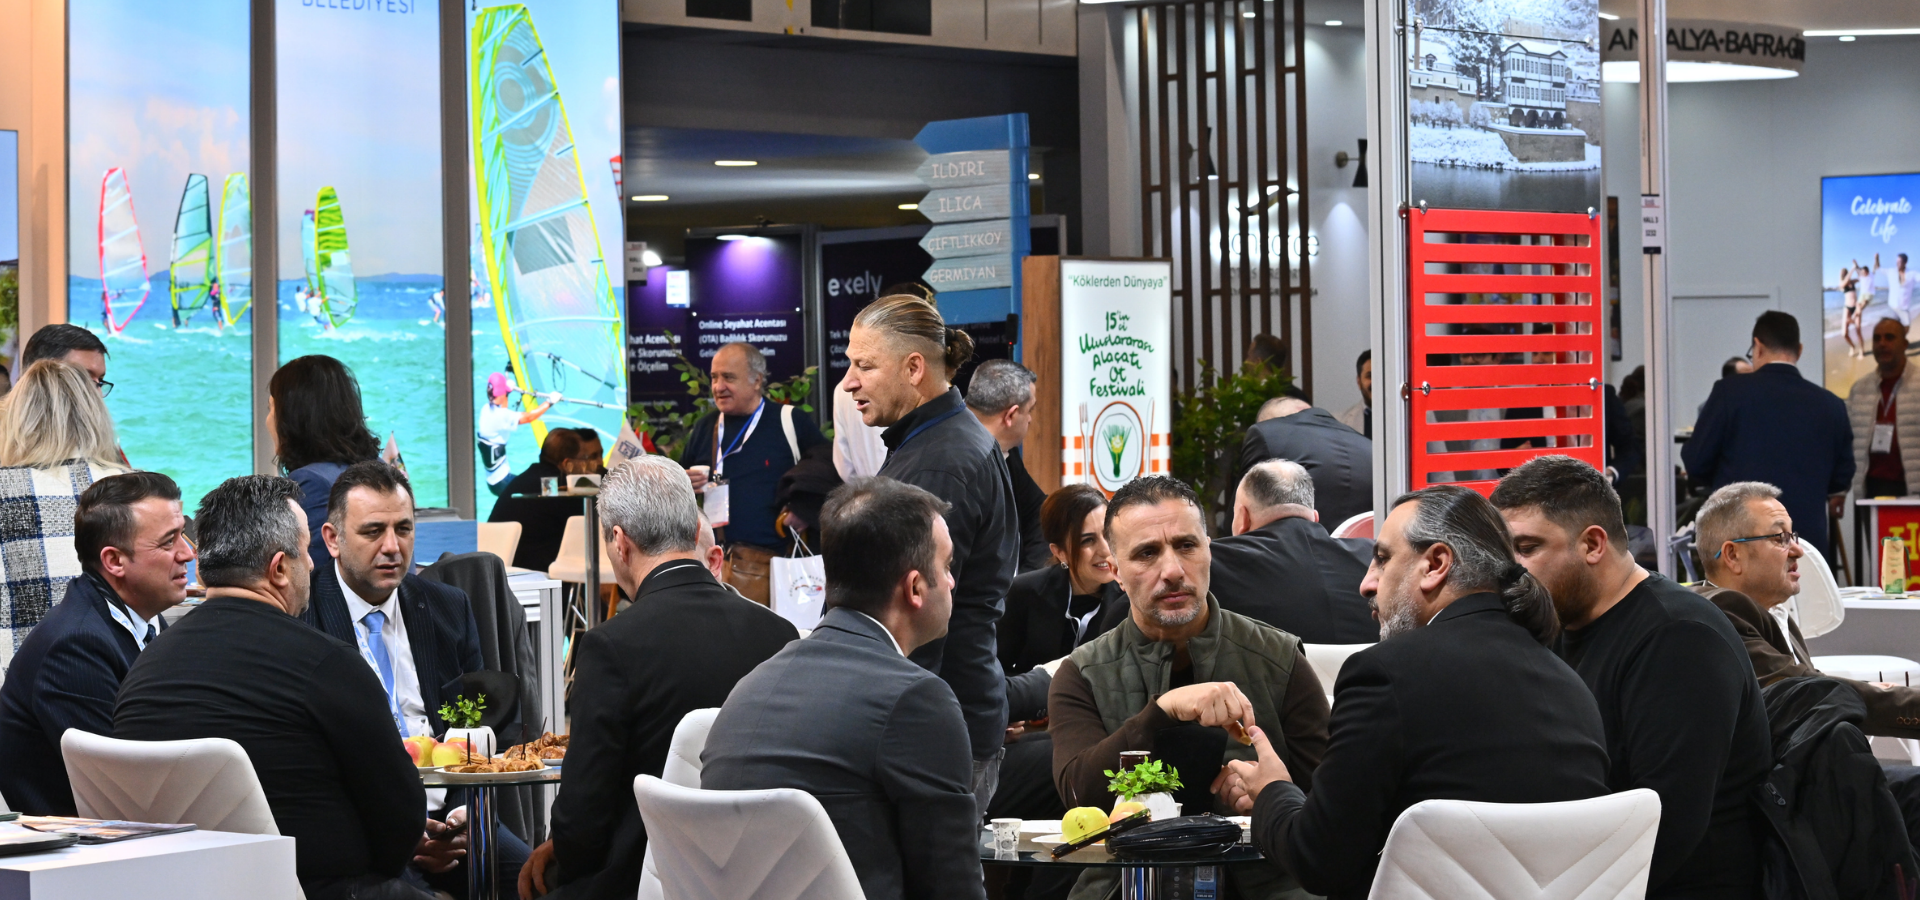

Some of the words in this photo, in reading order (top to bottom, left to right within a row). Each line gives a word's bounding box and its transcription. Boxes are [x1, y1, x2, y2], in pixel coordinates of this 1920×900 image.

[931, 160, 985, 179] ILDIRI
[938, 195, 982, 213] ILICA
[1851, 195, 1912, 216] Celebrate
[1870, 214, 1898, 244] Life
[929, 265, 996, 283] GERMIYAN
[827, 270, 882, 299] exely
[699, 320, 723, 330] Online
[723, 319, 753, 331] Seyahat
[754, 318, 787, 328] Acentası
[699, 335, 719, 345] (OTA)
[747, 333, 787, 342] Skorunuzu
[637, 360, 669, 374] Ölçelim
[1093, 350, 1143, 371] Alaçatı
[1109, 365, 1127, 383] Ot
[1090, 377, 1146, 397] Festivali
